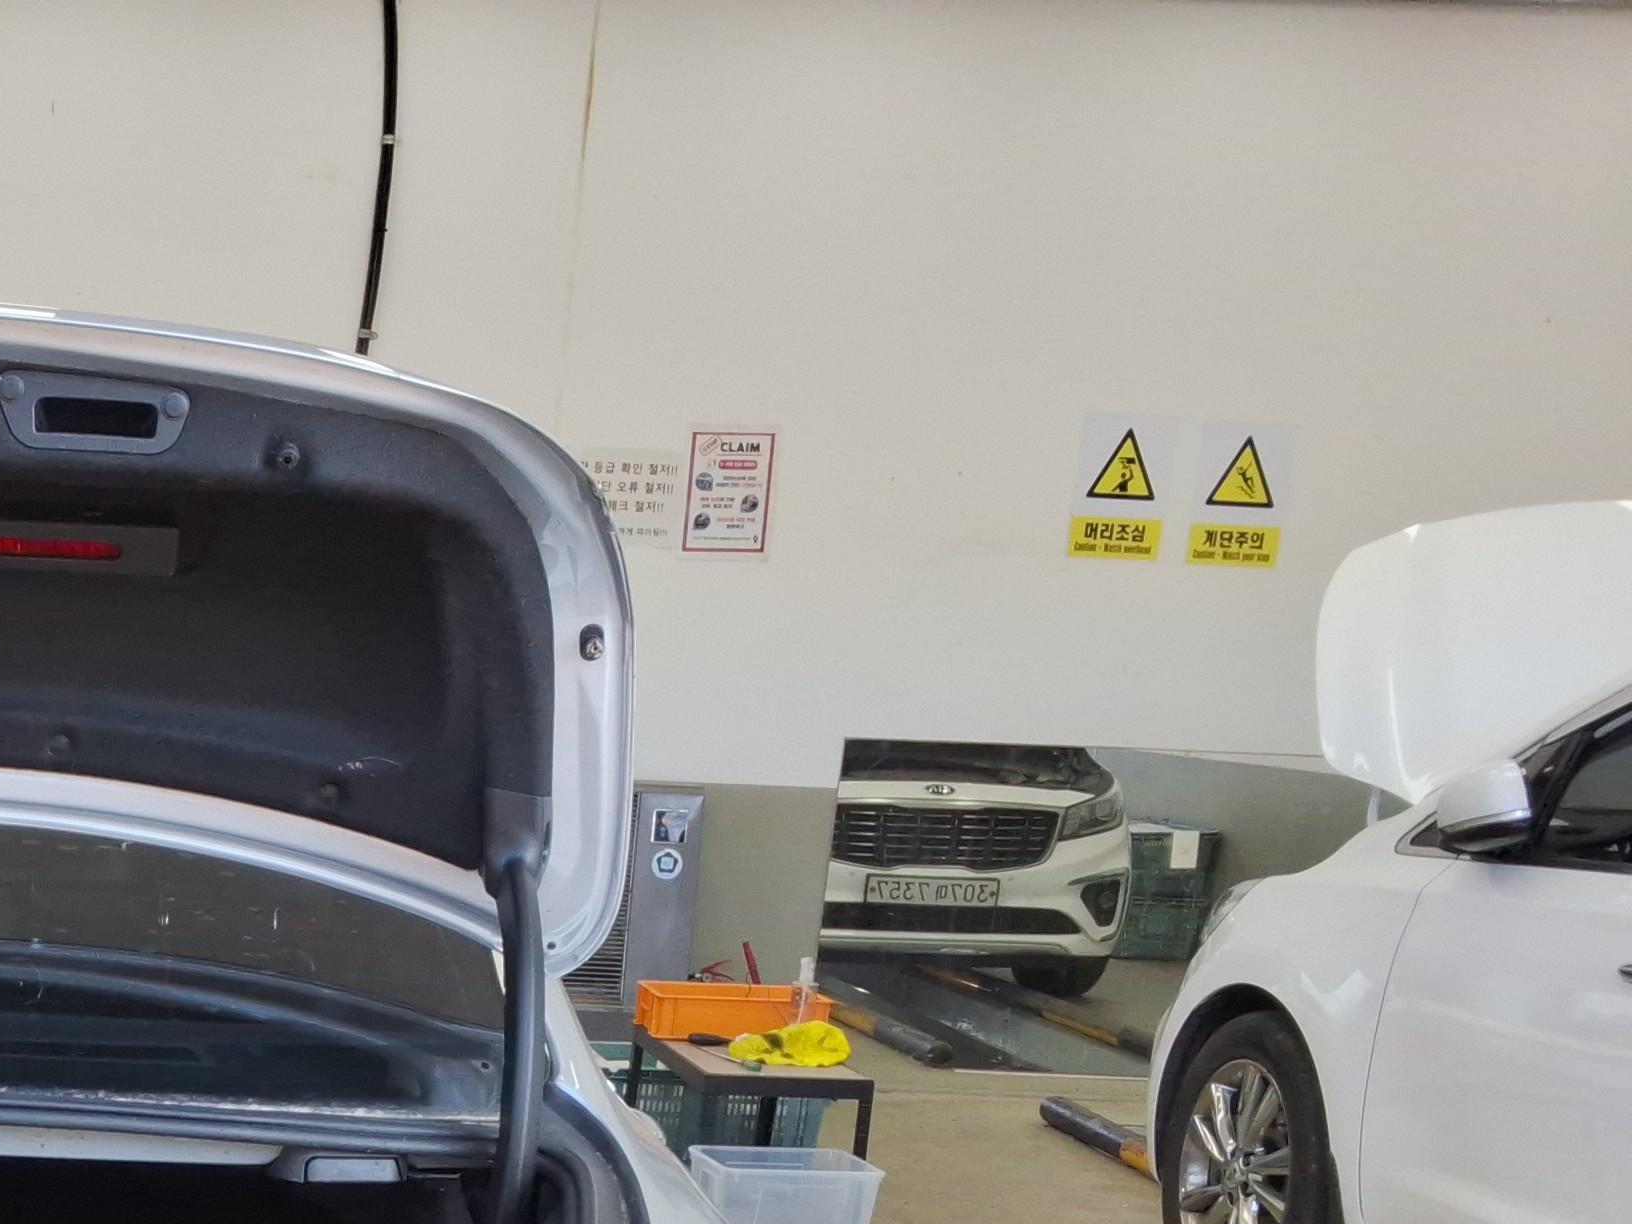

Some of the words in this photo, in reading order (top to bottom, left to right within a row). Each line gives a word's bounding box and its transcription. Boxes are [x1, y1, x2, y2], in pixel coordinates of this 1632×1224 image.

[720, 441, 761, 453] CLAIM
[594, 461, 615, 474] 등급
[622, 462, 643, 475] 확인
[616, 481, 639, 494] 오류
[1083, 522, 1146, 543] 머리조심
[1202, 530, 1265, 550] 계단주의
